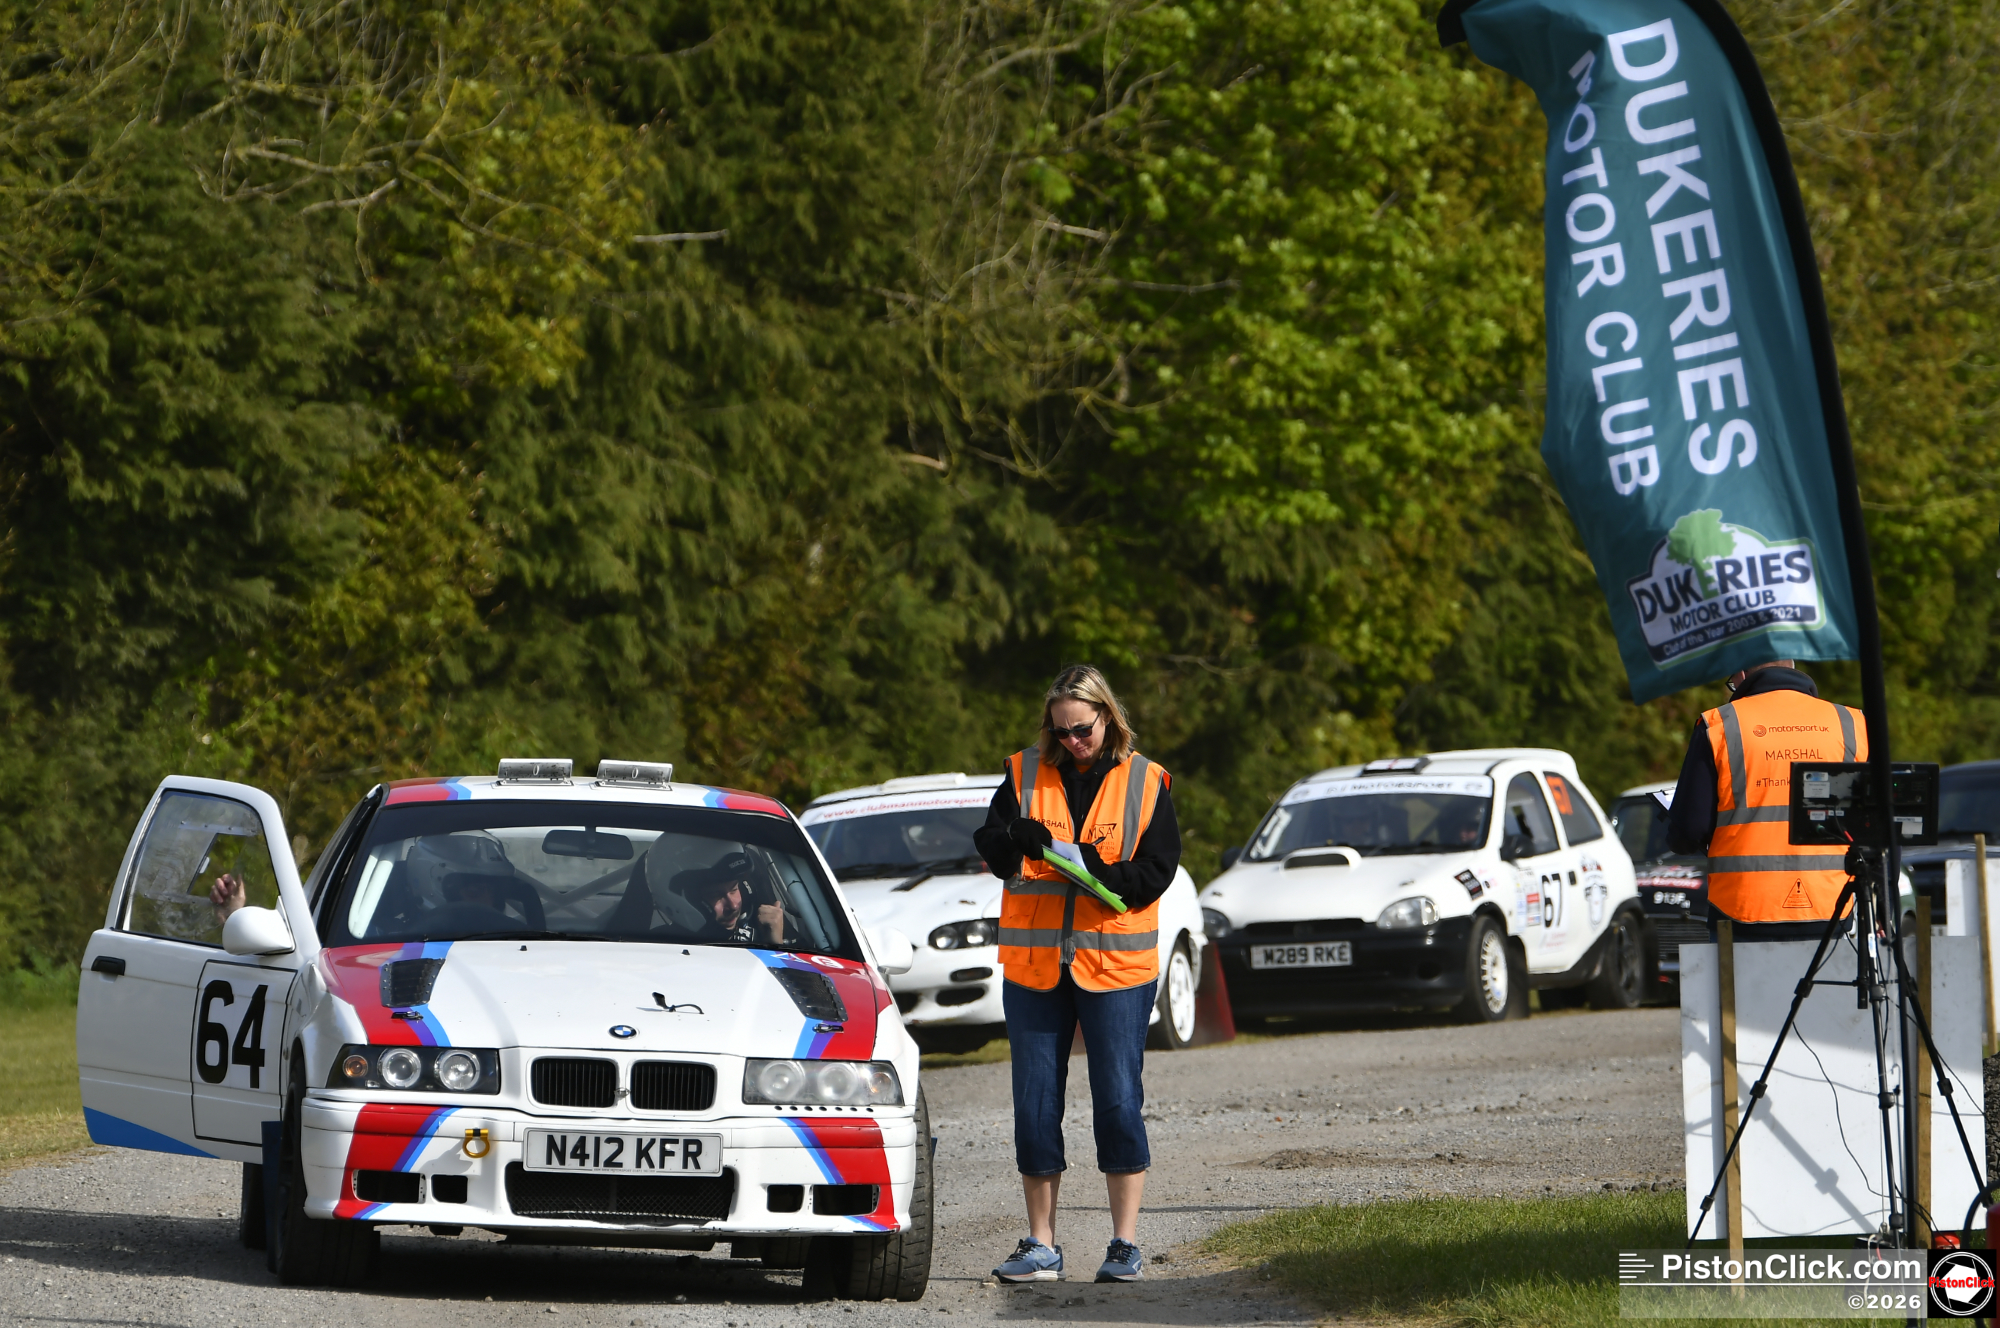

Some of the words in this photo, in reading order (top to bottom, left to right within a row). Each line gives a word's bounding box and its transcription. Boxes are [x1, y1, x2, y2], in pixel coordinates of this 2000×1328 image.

[1562, 50, 1626, 298] MOTOR
[1607, 17, 1758, 475] DUKERIES
[1585, 311, 1660, 496] CLUB
[1634, 550, 1812, 624] DUKERIES
[1669, 602, 1721, 634] MOTOR
[1724, 589, 1776, 614] CLUB
[1688, 630, 1704, 645] the
[1704, 625, 1725, 639] Year
[1727, 614, 1756, 632] 2003
[1771, 607, 1801, 619] 2021
[1768, 725, 1818, 733] motorsport
[1765, 749, 1823, 761] MARSHAL
[1087, 825, 1115, 841] MSA
[1541, 873, 1562, 928] 67
[196, 979, 267, 1089] 64
[545, 1134, 625, 1169] N412
[635, 1137, 703, 1170] KFR
